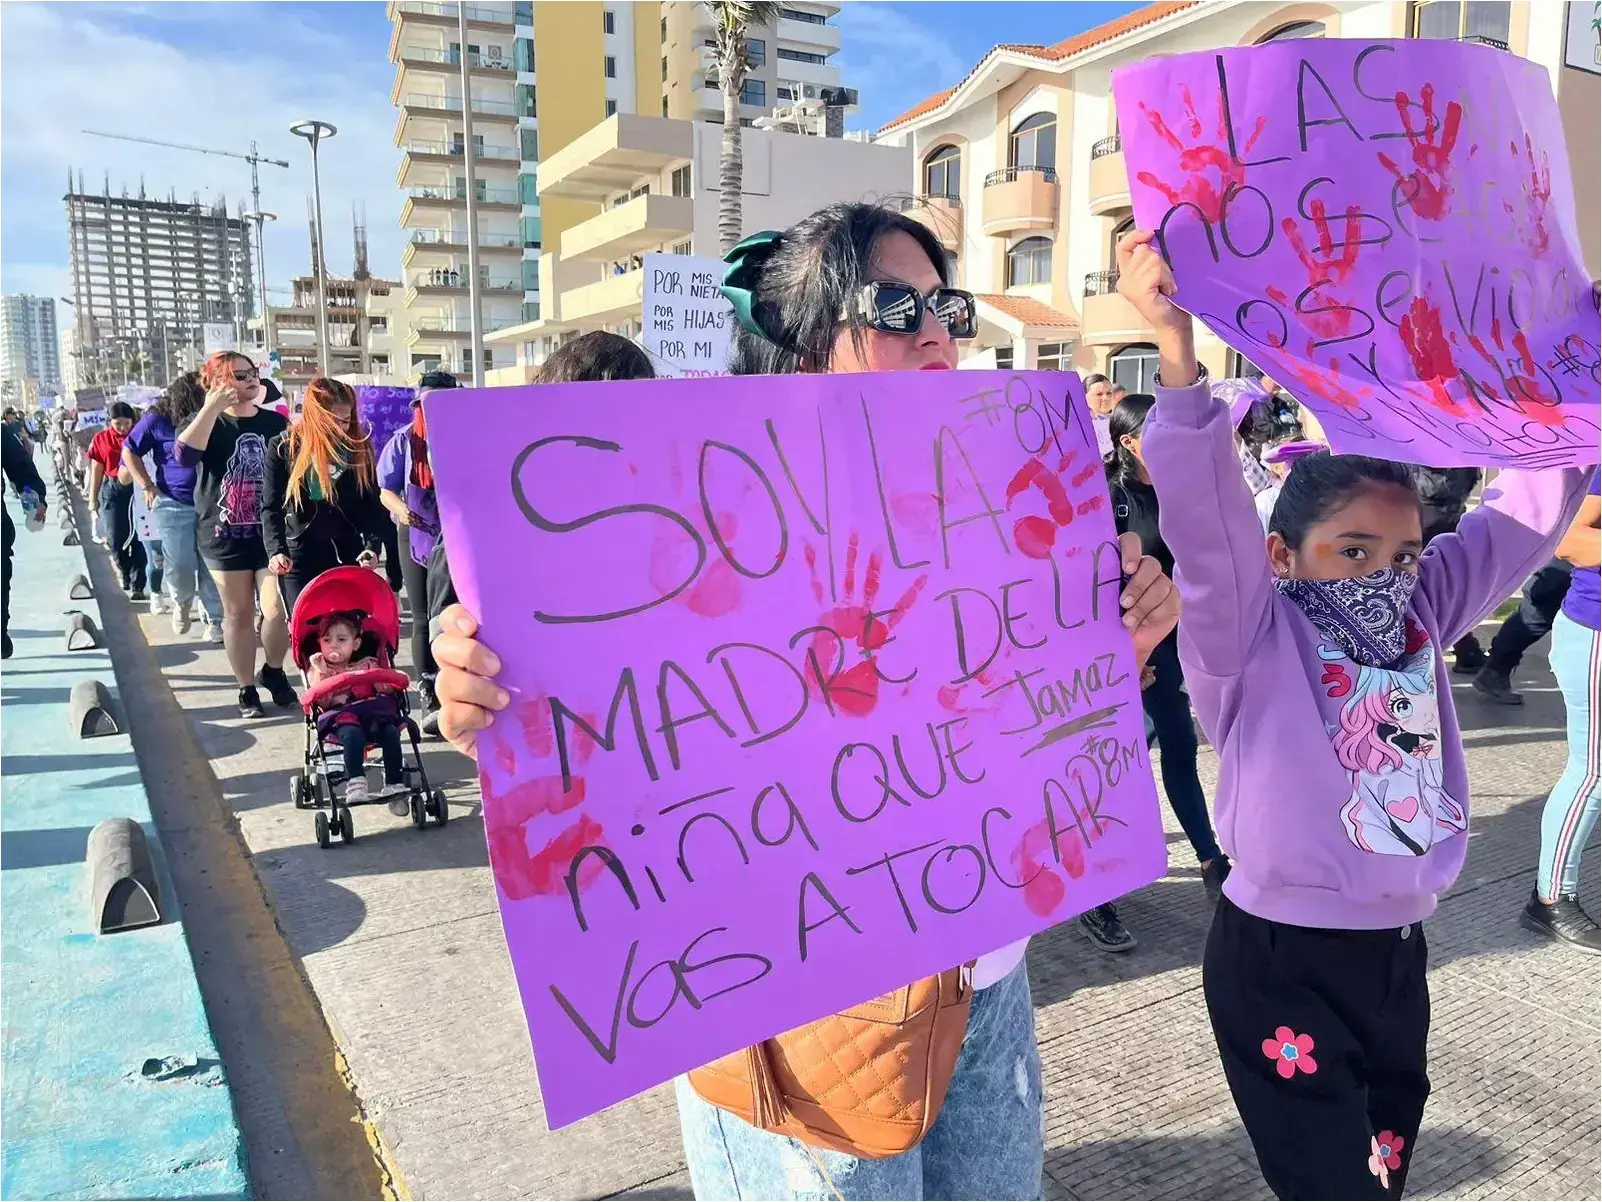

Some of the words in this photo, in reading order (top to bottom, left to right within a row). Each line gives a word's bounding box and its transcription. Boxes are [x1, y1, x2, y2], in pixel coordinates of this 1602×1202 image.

[1215, 45, 1441, 168] LAS
[653, 304, 674, 318] POR
[653, 320, 674, 332] MIS
[684, 308, 726, 330] HIJAS
[654, 269, 683, 295] POR
[691, 272, 713, 285] MIS
[660, 339, 686, 360] POR
[694, 341, 712, 359] MI
[957, 375, 1091, 456] #8M
[510, 405, 837, 625] SOY
[859, 390, 1012, 570] LA
[548, 607, 918, 794] MADRE
[932, 578, 1049, 685] DE
[830, 716, 987, 823] QUE
[1079, 734, 1143, 788] #8M
[797, 871, 865, 964] A
[845, 753, 1129, 934] TOCAR
